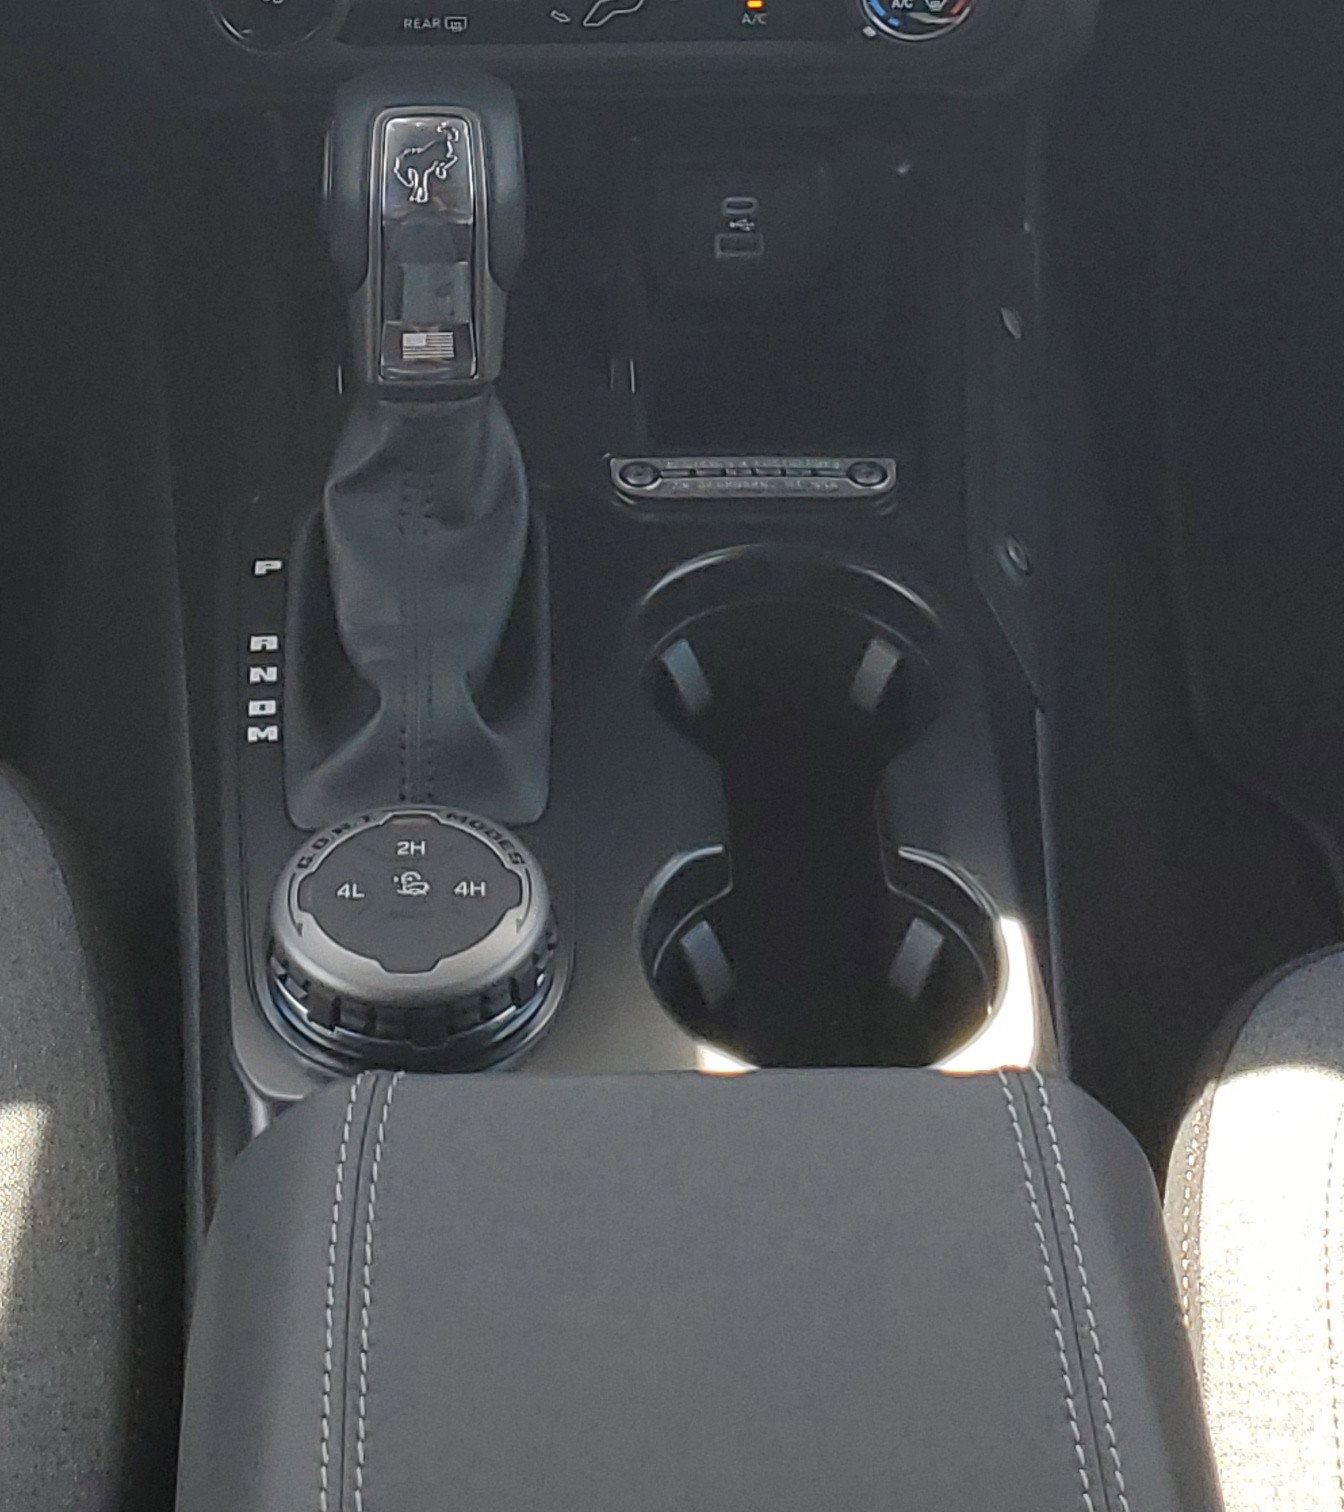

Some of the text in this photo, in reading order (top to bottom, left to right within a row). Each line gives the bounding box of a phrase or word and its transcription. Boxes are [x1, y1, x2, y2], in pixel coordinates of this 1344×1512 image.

[403, 17, 441, 29] REAR
[741, 12, 767, 26] A/C
[254, 560, 283, 576] P
[249, 666, 278, 682] N
[247, 725, 278, 742] M
[445, 811, 526, 866] MODES
[397, 840, 425, 856] 2H
[336, 882, 366, 899] 4L
[453, 881, 486, 896] 4H
